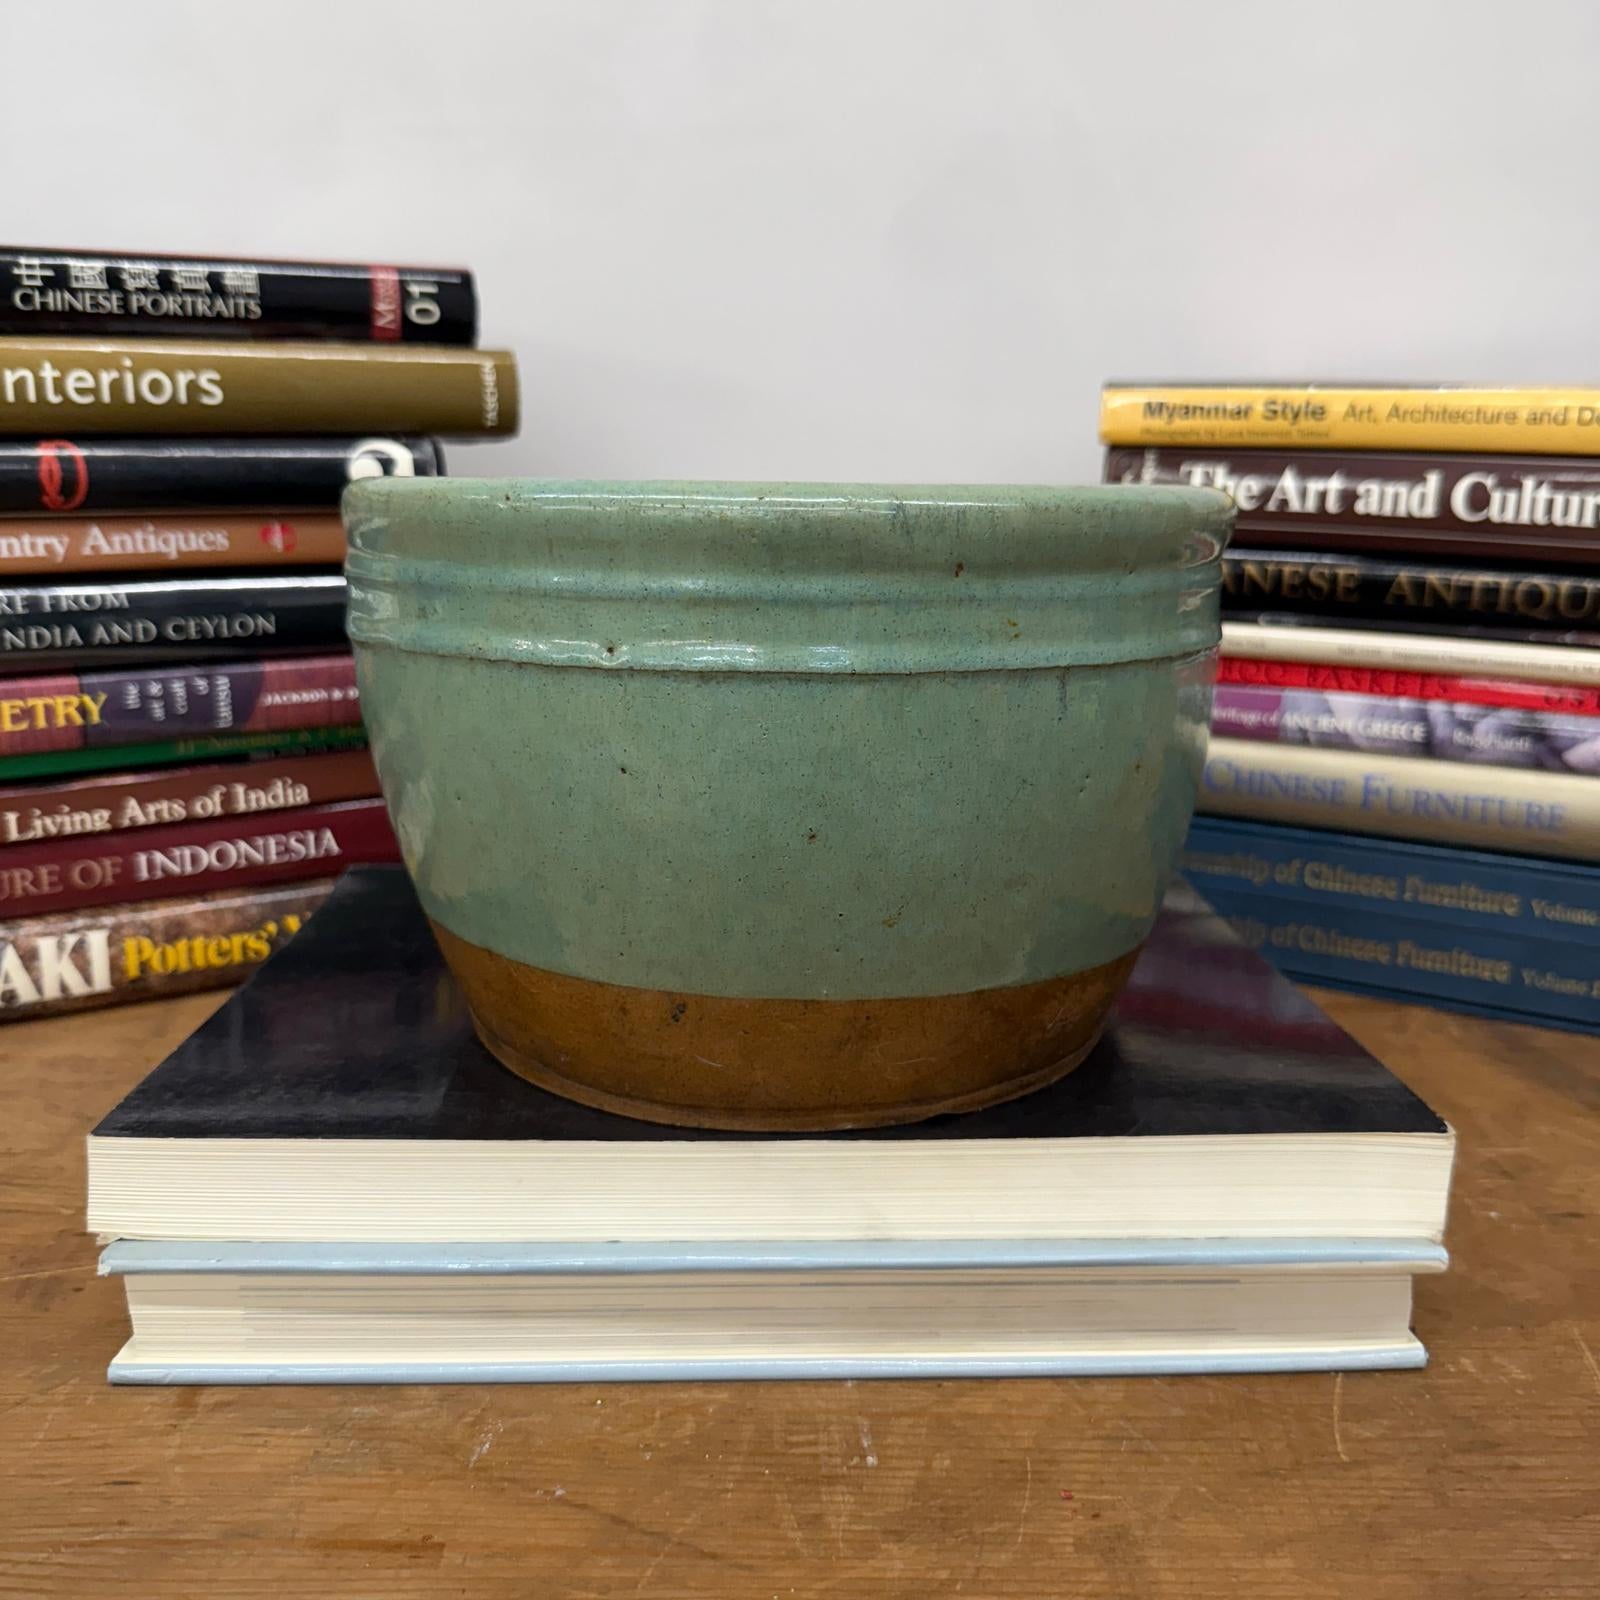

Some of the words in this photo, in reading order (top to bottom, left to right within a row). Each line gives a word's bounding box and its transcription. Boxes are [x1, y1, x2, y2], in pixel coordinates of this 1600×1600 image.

[13, 287, 125, 315] CHINESE
[129, 290, 262, 319] PORTRAITS
[404, 281, 441, 325] 01
[2, 357, 224, 405] nteriors
[1142, 401, 1253, 425] Myanmar
[1262, 399, 1328, 425] Style
[1386, 402, 1517, 425] Architecture
[1525, 406, 1568, 426] and
[1179, 460, 1262, 511] The
[1263, 462, 1347, 515] Art
[1353, 468, 1444, 519] and
[1450, 470, 1600, 528] Cultur
[0, 526, 70, 562] ntry
[80, 521, 230, 561] Antiques
[42, 590, 130, 613] FROM
[2, 624, 84, 651] NDIA
[91, 618, 157, 647] AND
[163, 612, 277, 641] CEYLON
[0, 691, 108, 732] ETRY
[1358, 716, 1428, 743] GREECE
[2, 804, 112, 842] Living
[121, 796, 188, 828] Arts
[189, 785, 226, 819] of
[229, 776, 311, 813] India
[72, 856, 123, 889] OF
[133, 827, 342, 882] INDONESIA
[1303, 861, 1398, 900] Chinese
[1402, 874, 1520, 917] Furniture
[1299, 923, 1393, 965] Chinese
[0, 928, 113, 1008] AKI
